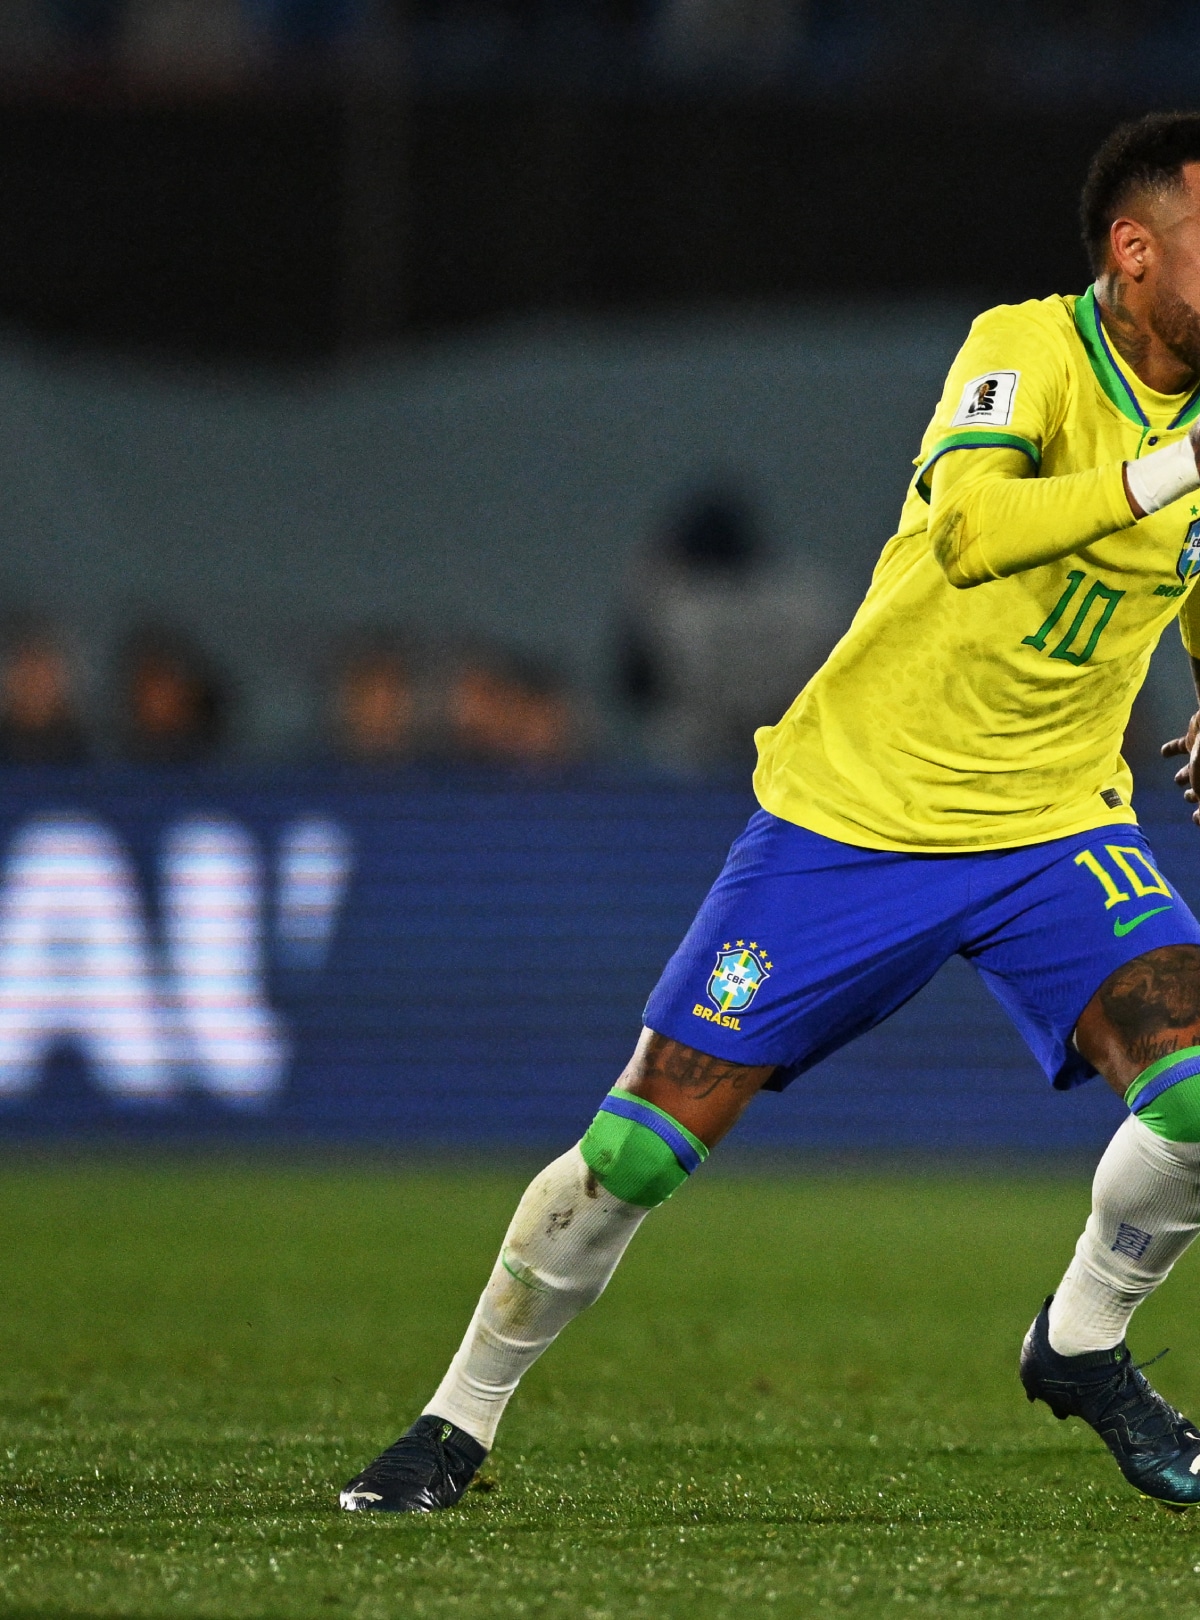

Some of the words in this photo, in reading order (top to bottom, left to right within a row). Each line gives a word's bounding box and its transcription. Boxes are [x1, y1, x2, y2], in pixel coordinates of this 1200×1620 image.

[1153, 585, 1188, 597] BRAS
[1021, 570, 1126, 667] 10
[1073, 844, 1174, 911] 10
[726, 973, 746, 985] CBF
[692, 1003, 742, 1031] BRASIL
